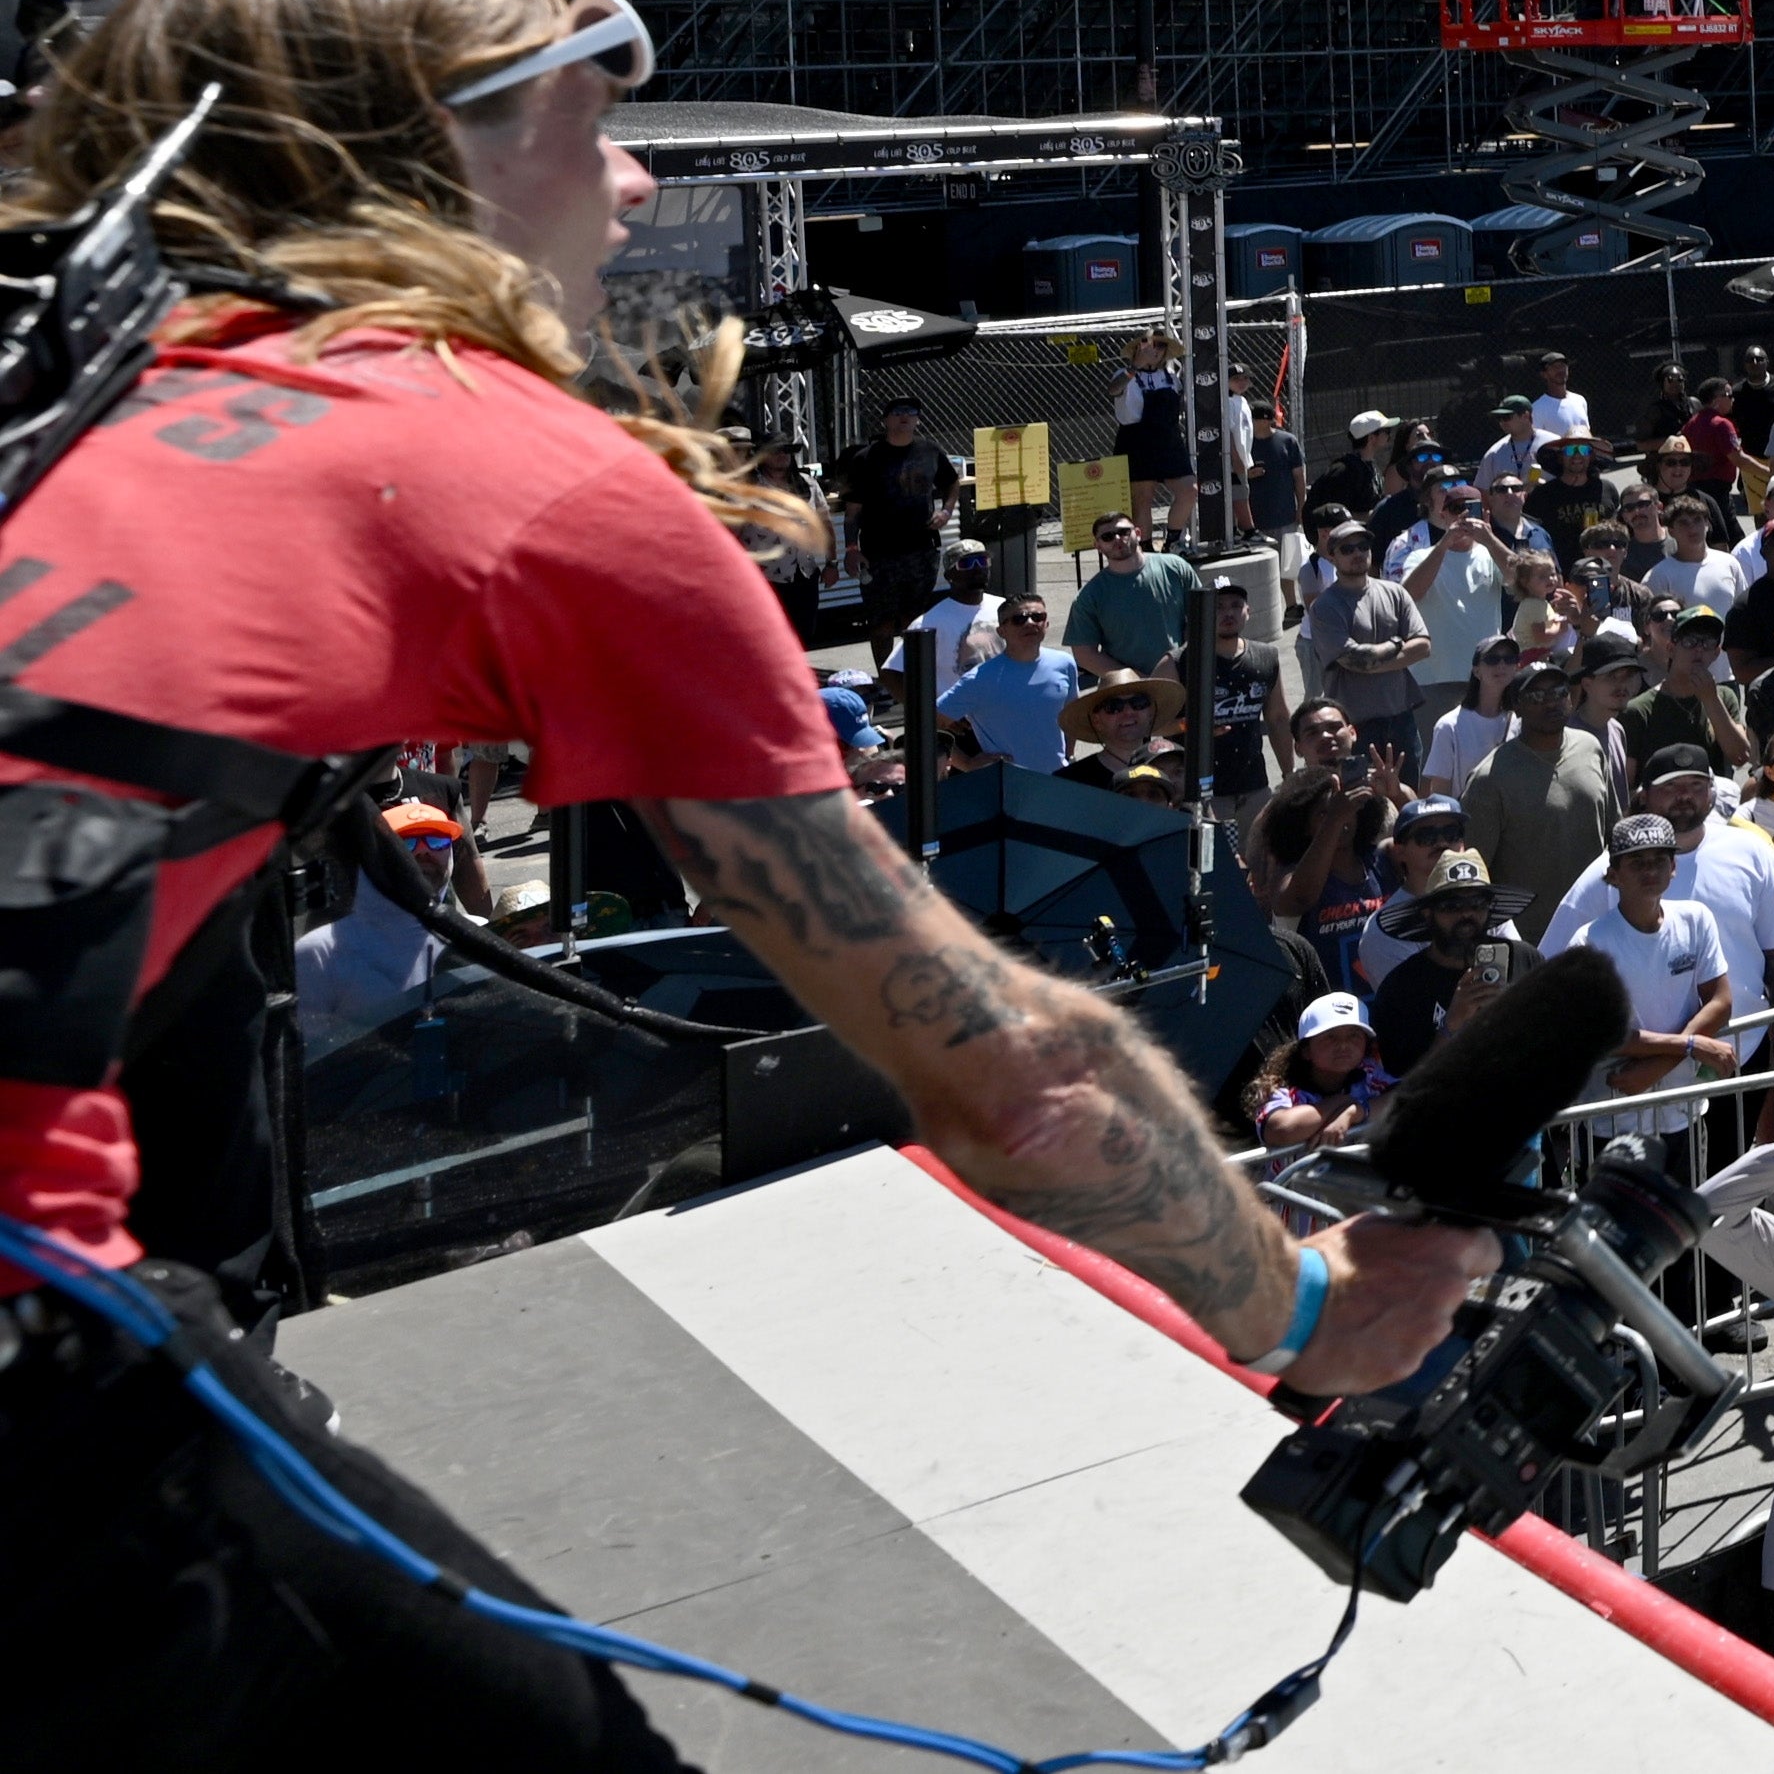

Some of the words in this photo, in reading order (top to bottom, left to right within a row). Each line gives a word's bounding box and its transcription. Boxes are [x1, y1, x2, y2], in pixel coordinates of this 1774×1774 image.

[1533, 24, 1583, 35] SKYJACK
[1151, 141, 1244, 178] 805
[1545, 192, 1585, 208] SKYJACK
[850, 310, 926, 333] 805
[1627, 827, 1664, 844] VANS
[1318, 903, 1361, 923] CHECK
[1318, 923, 1334, 935] GET
